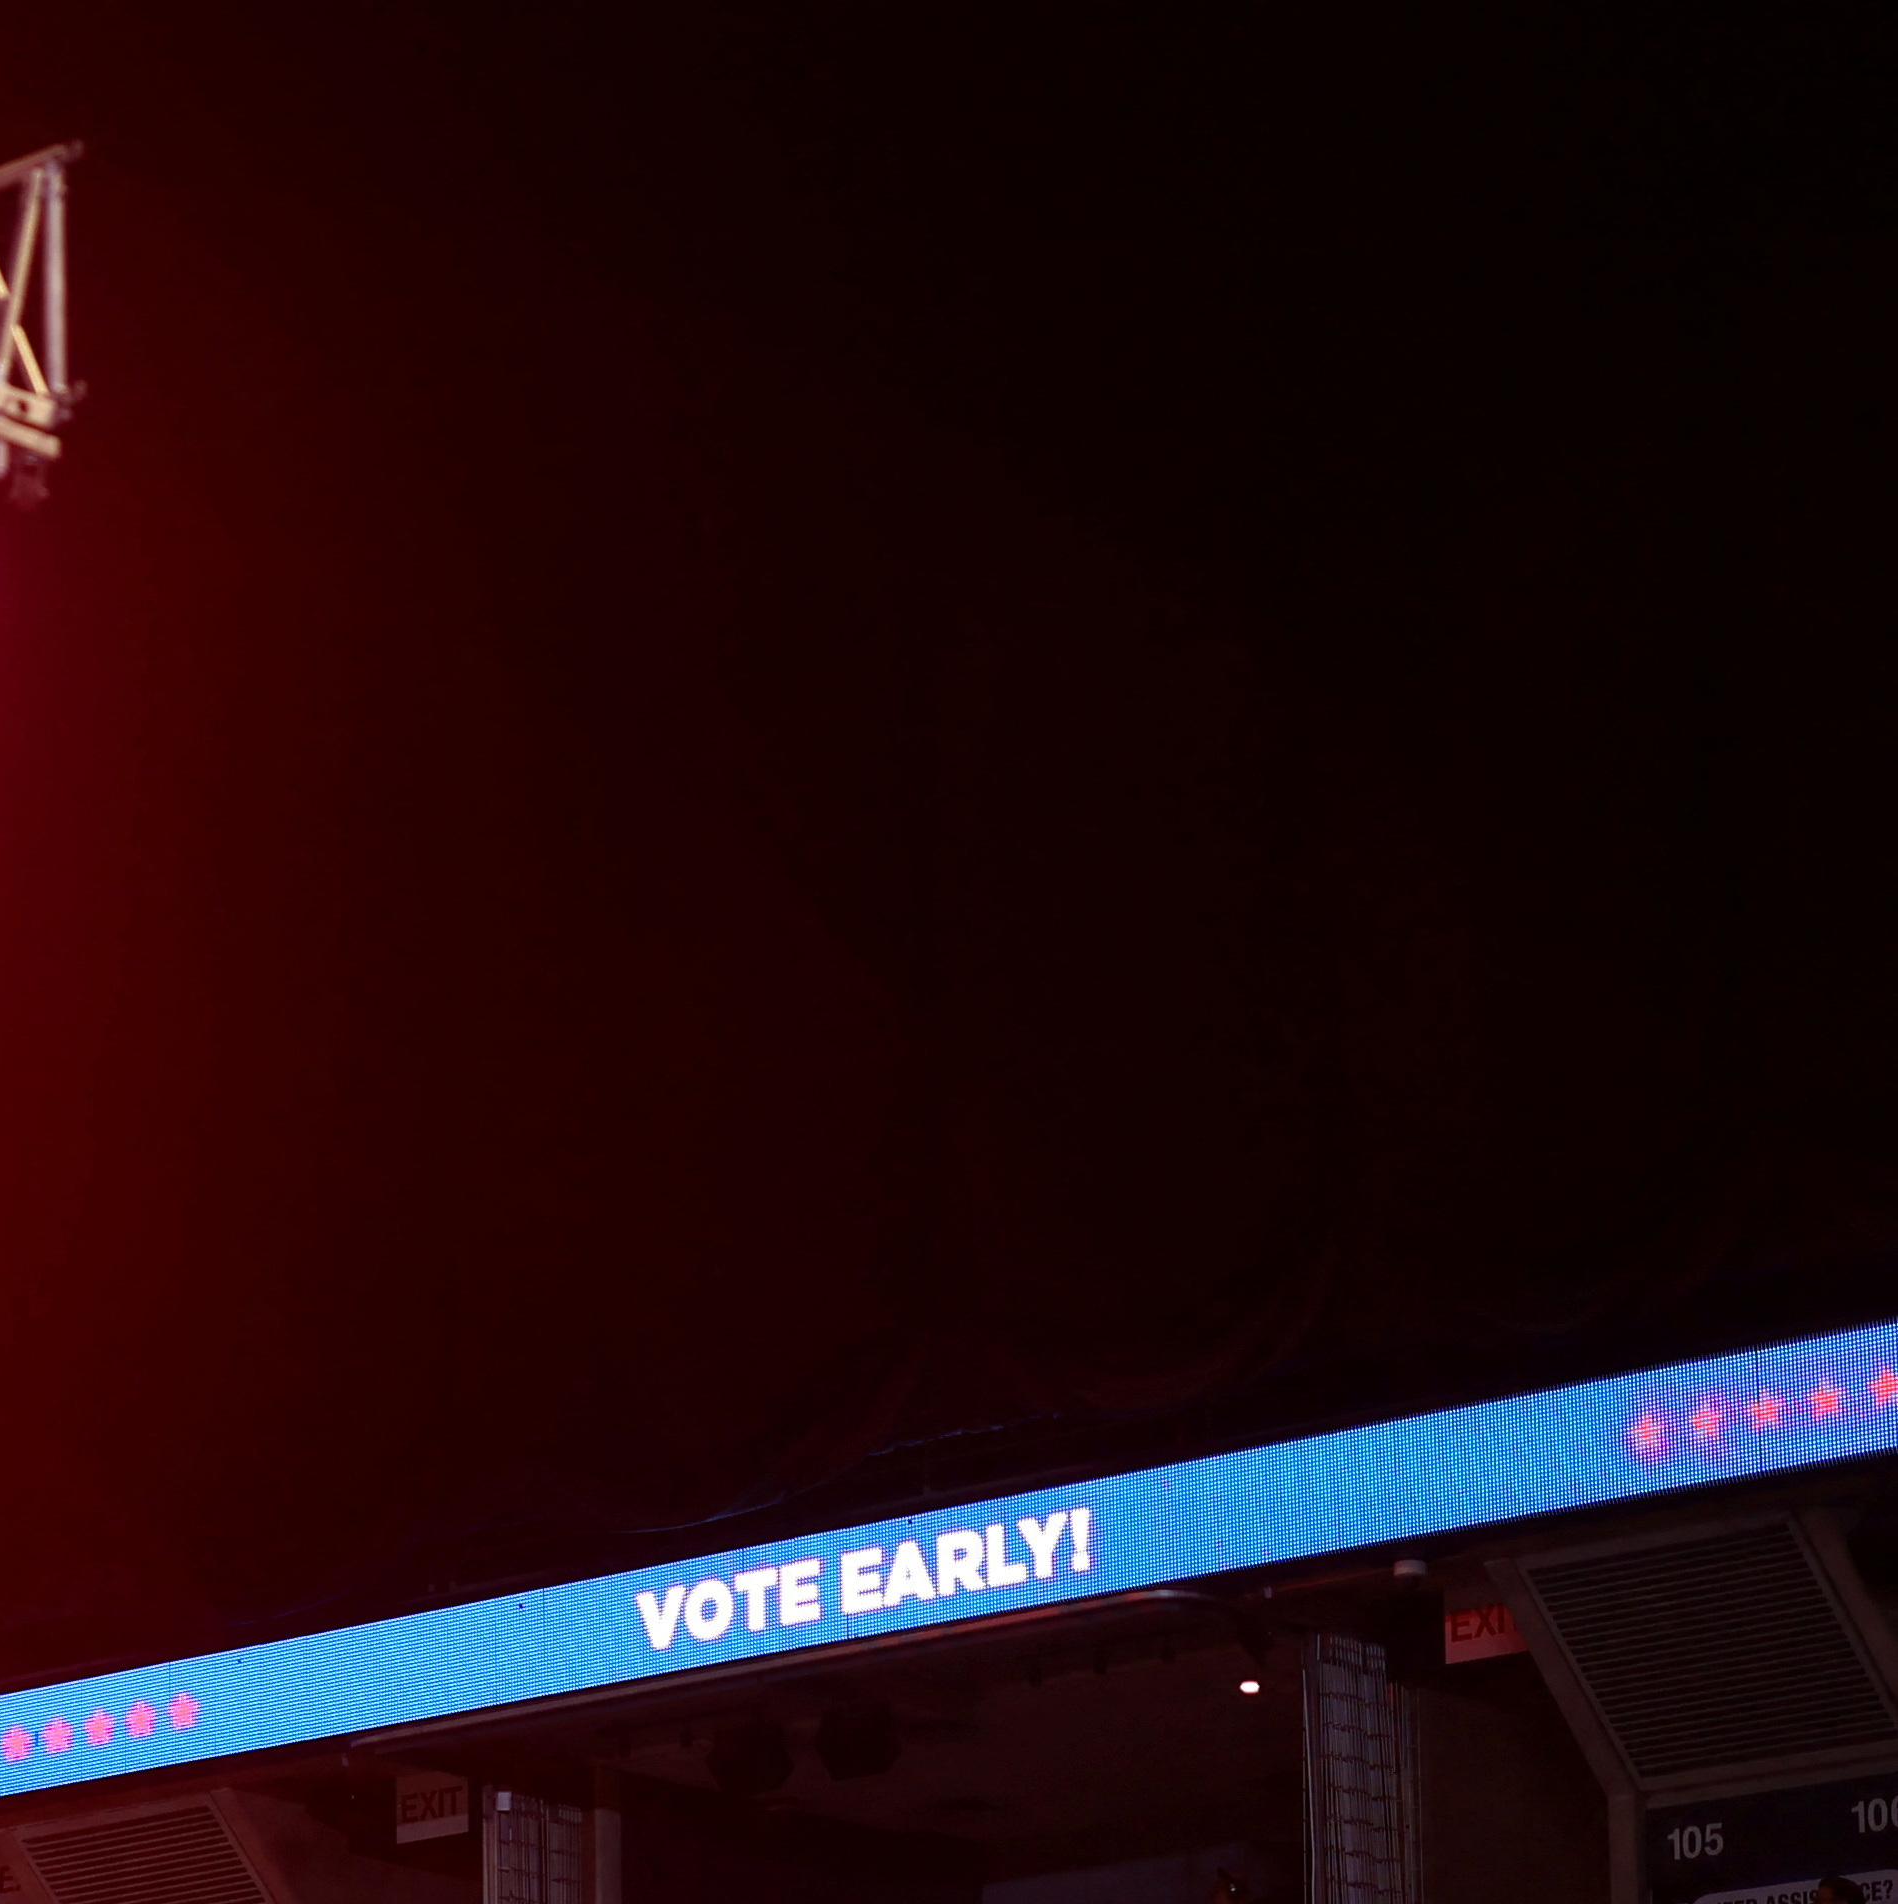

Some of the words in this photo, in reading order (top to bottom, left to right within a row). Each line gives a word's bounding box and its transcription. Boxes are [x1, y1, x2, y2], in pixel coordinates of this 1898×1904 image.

[638, 1551, 824, 1650] VOTE
[839, 1508, 1089, 1614] EARLY!
[1450, 1602, 1518, 1642] EXI
[401, 1786, 462, 1822] EXIT
[1667, 1821, 1725, 1861] 105
